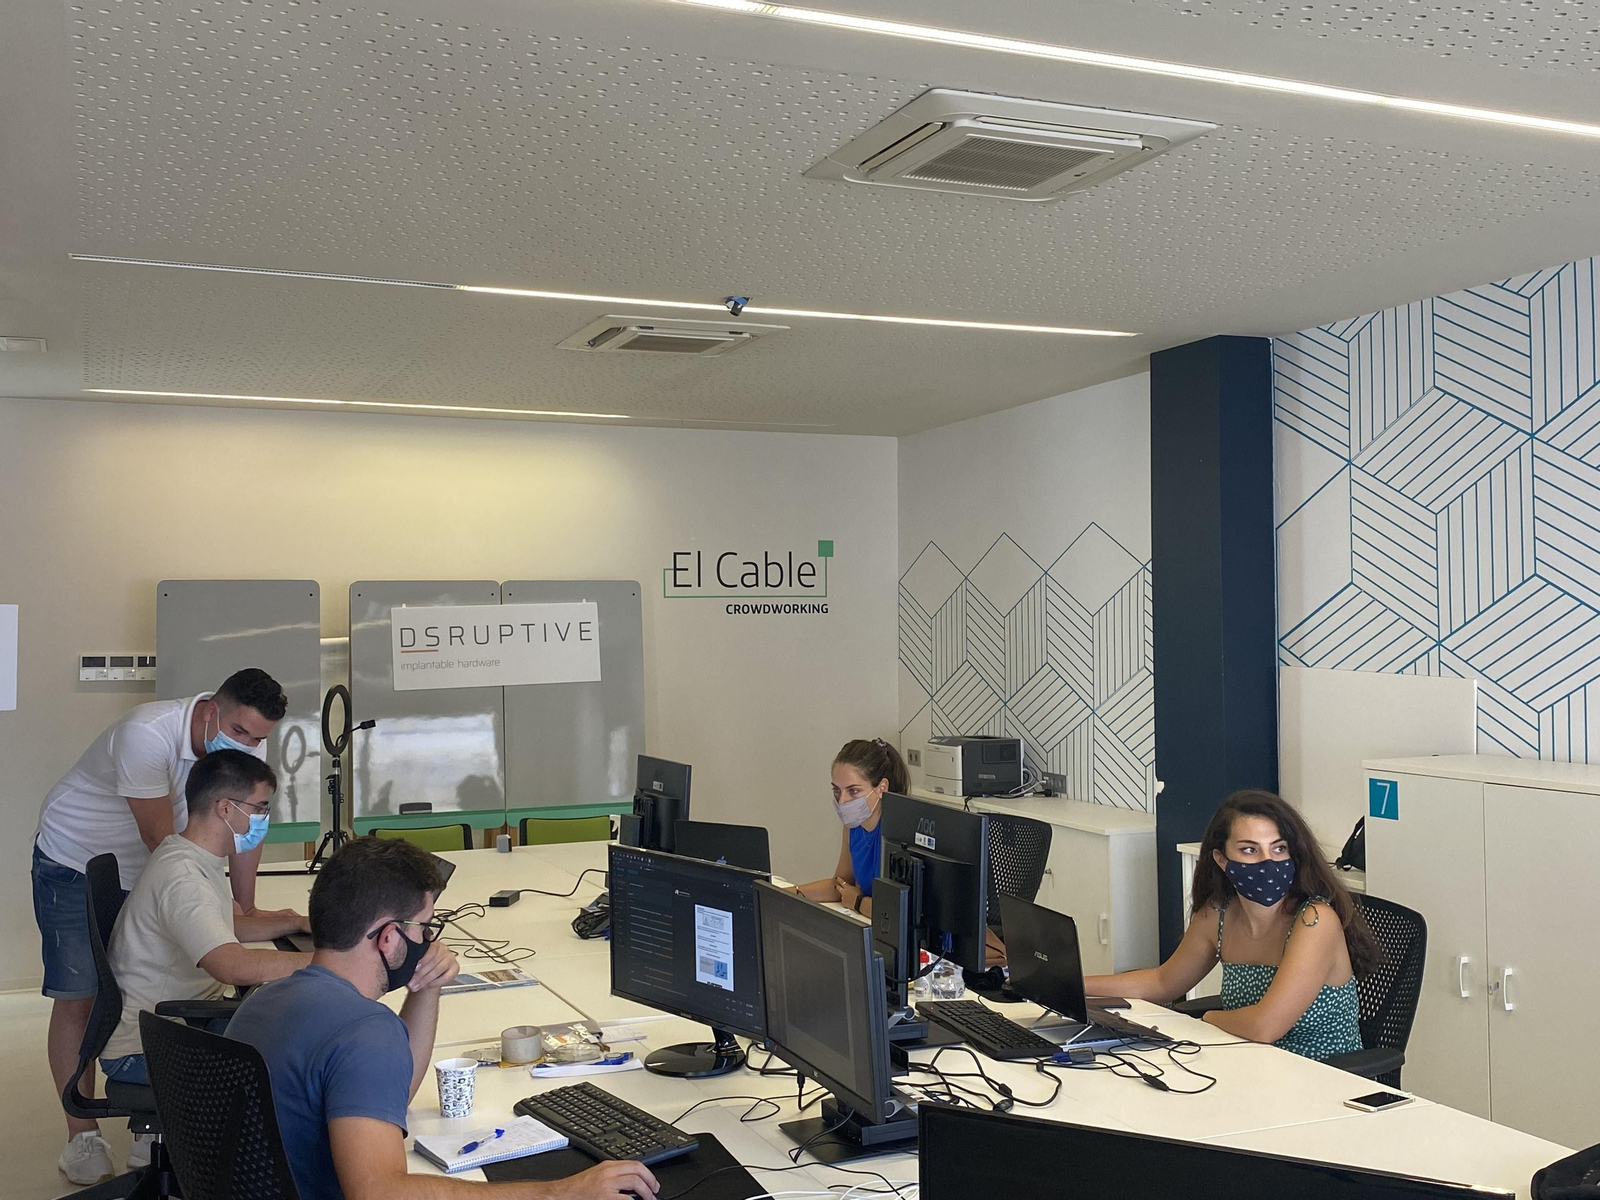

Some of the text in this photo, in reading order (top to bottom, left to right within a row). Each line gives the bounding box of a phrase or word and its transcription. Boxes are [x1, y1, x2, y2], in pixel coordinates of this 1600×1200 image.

[673, 550, 817, 588] El Cable
[725, 603, 829, 615] CROWDWORKING
[400, 621, 593, 648] DSRUPTIVE
[400, 658, 501, 672] implantable hardware
[1376, 782, 1391, 815] 7
